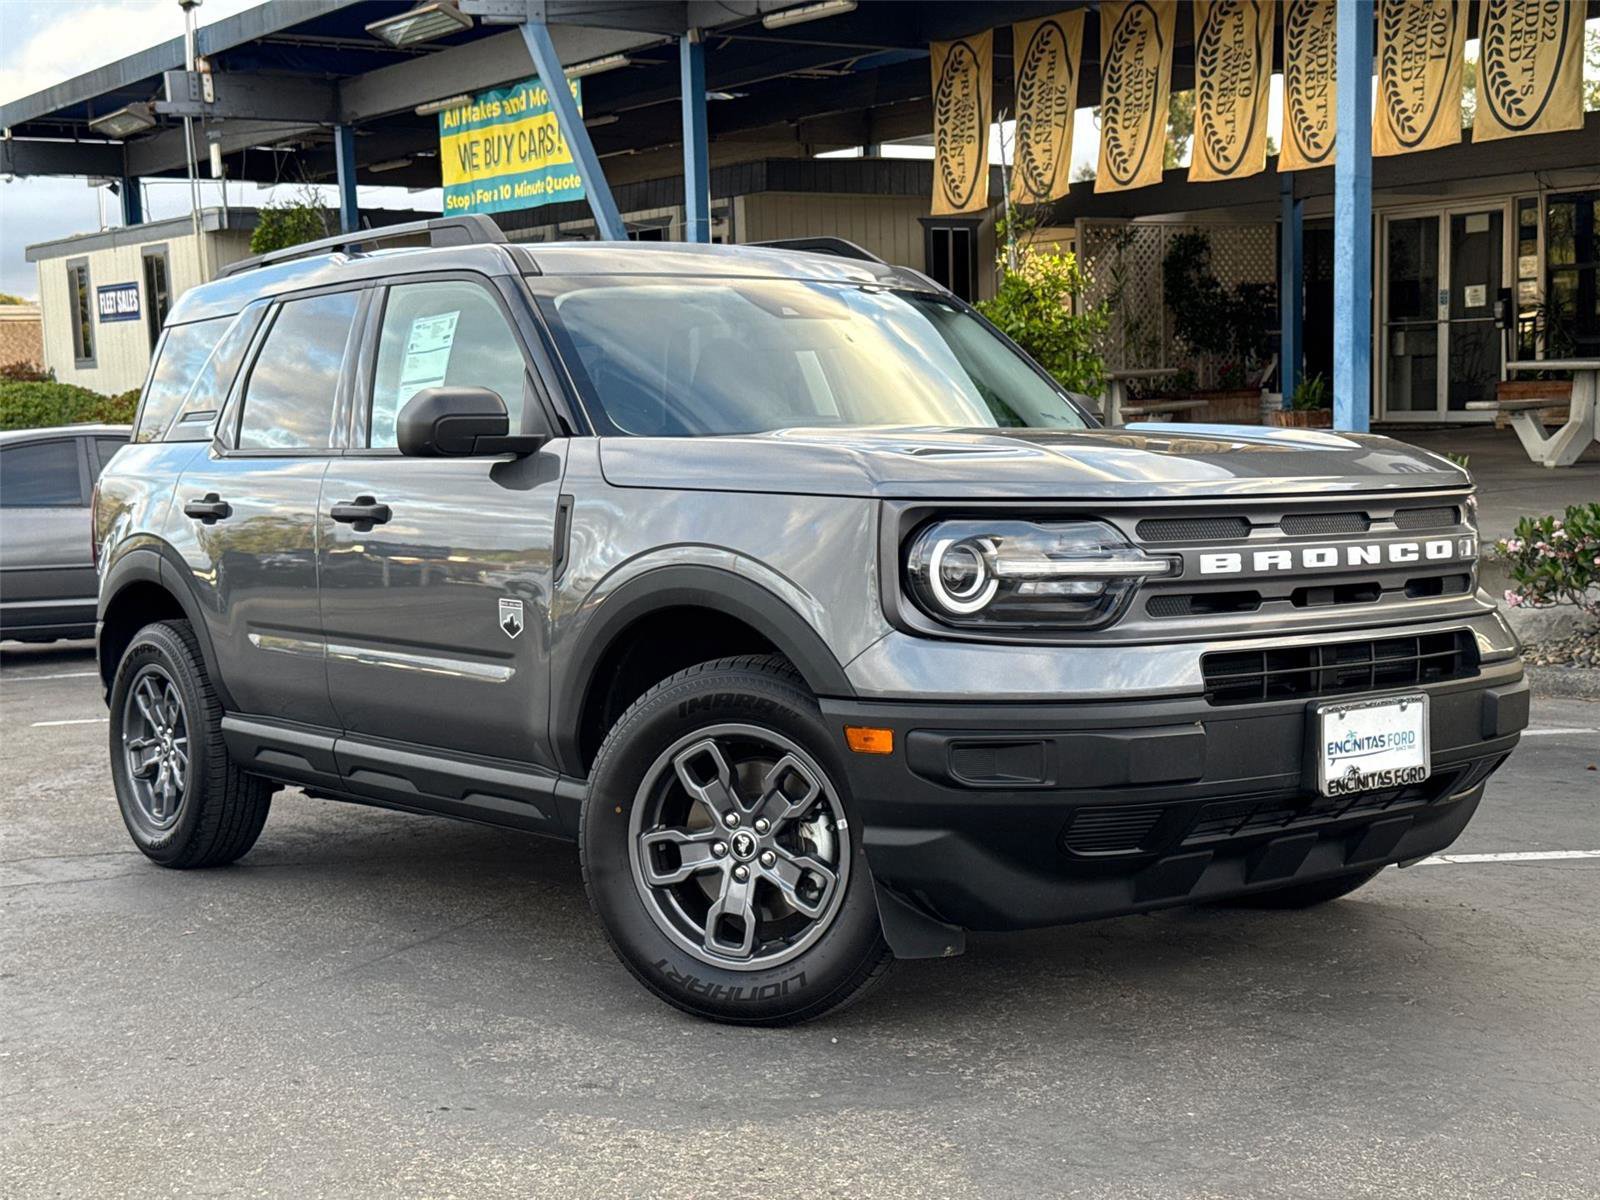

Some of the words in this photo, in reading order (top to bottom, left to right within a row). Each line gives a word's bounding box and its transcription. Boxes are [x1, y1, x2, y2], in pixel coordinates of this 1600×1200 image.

[1400, 4, 1420, 82] AWARD
[1429, 9, 1447, 60] 2021
[1216, 43, 1233, 116] AWARD
[1225, 10, 1245, 145] PRESIDENT'S
[1238, 48, 1253, 98] 2019
[1304, 25, 1321, 100] AWARD
[444, 109, 459, 129] All
[462, 101, 501, 125] Makes
[502, 90, 527, 115] and
[1034, 79, 1048, 145] AWARD
[1042, 50, 1057, 171] PRESIDENT'S
[1054, 84, 1067, 129] 2017
[1122, 60, 1135, 130] AWARD
[1129, 29, 1148, 157] PRESIDENT'S
[458, 140, 481, 174] WE
[484, 133, 515, 168] BUY
[518, 123, 564, 162] CARS!
[950, 95, 963, 159] AWARD
[957, 66, 970, 184] PRESIDENT'S
[966, 102, 976, 144] 2016
[447, 194, 471, 210] Stop
[476, 188, 493, 204] For
[499, 185, 512, 199] 10
[545, 174, 582, 193] Quote
[99, 291, 116, 315] FLEET
[117, 289, 139, 313] SALES
[1200, 540, 1453, 574] BRONCO
[1327, 735, 1386, 756] ENCINITAS
[1387, 730, 1415, 747] FORD
[1328, 770, 1393, 795] ENCINITAS
[1394, 766, 1426, 785] FORD
[650, 956, 808, 1001] LIONHART
